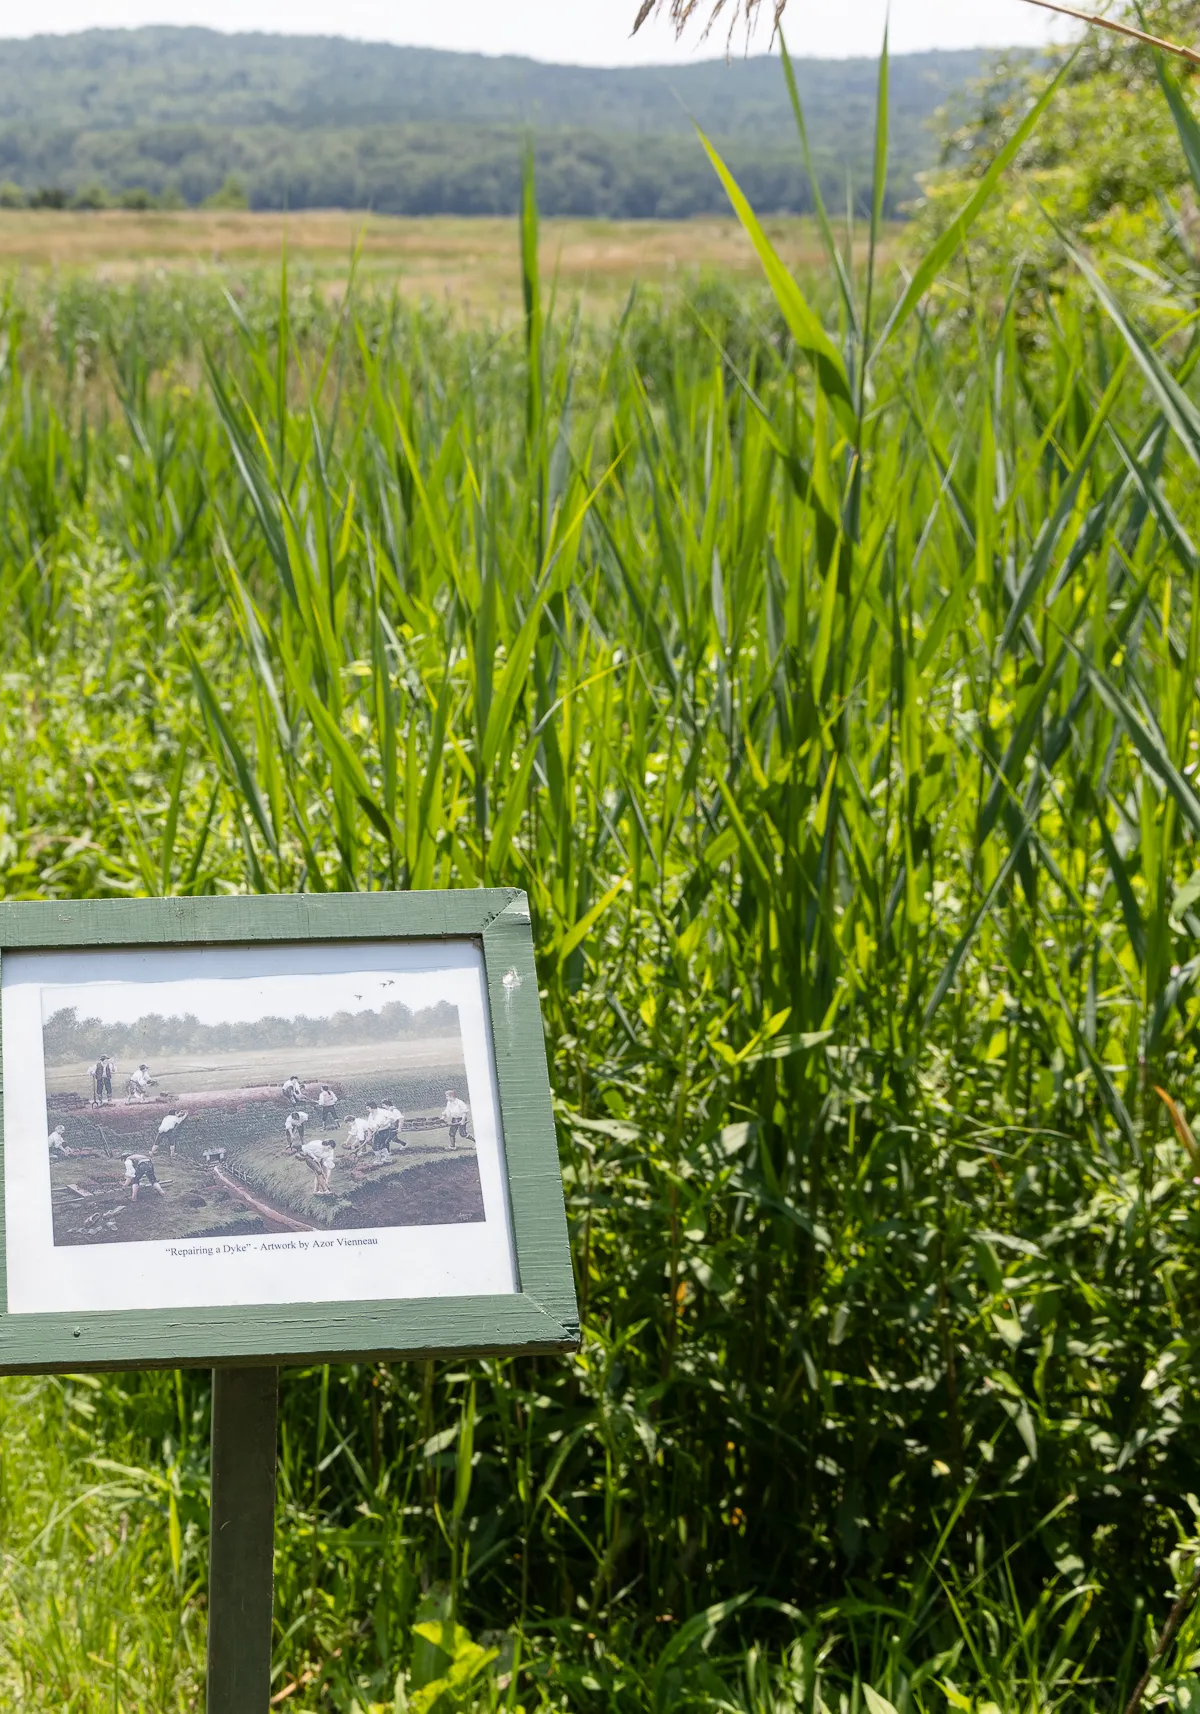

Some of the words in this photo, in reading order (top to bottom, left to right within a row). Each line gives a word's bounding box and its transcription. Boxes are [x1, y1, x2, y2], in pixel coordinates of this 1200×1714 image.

[260, 1241, 297, 1251] Artwork
[298, 1240, 310, 1251] by
[312, 1239, 335, 1249] Azor
[336, 1237, 378, 1247] Vienneau
